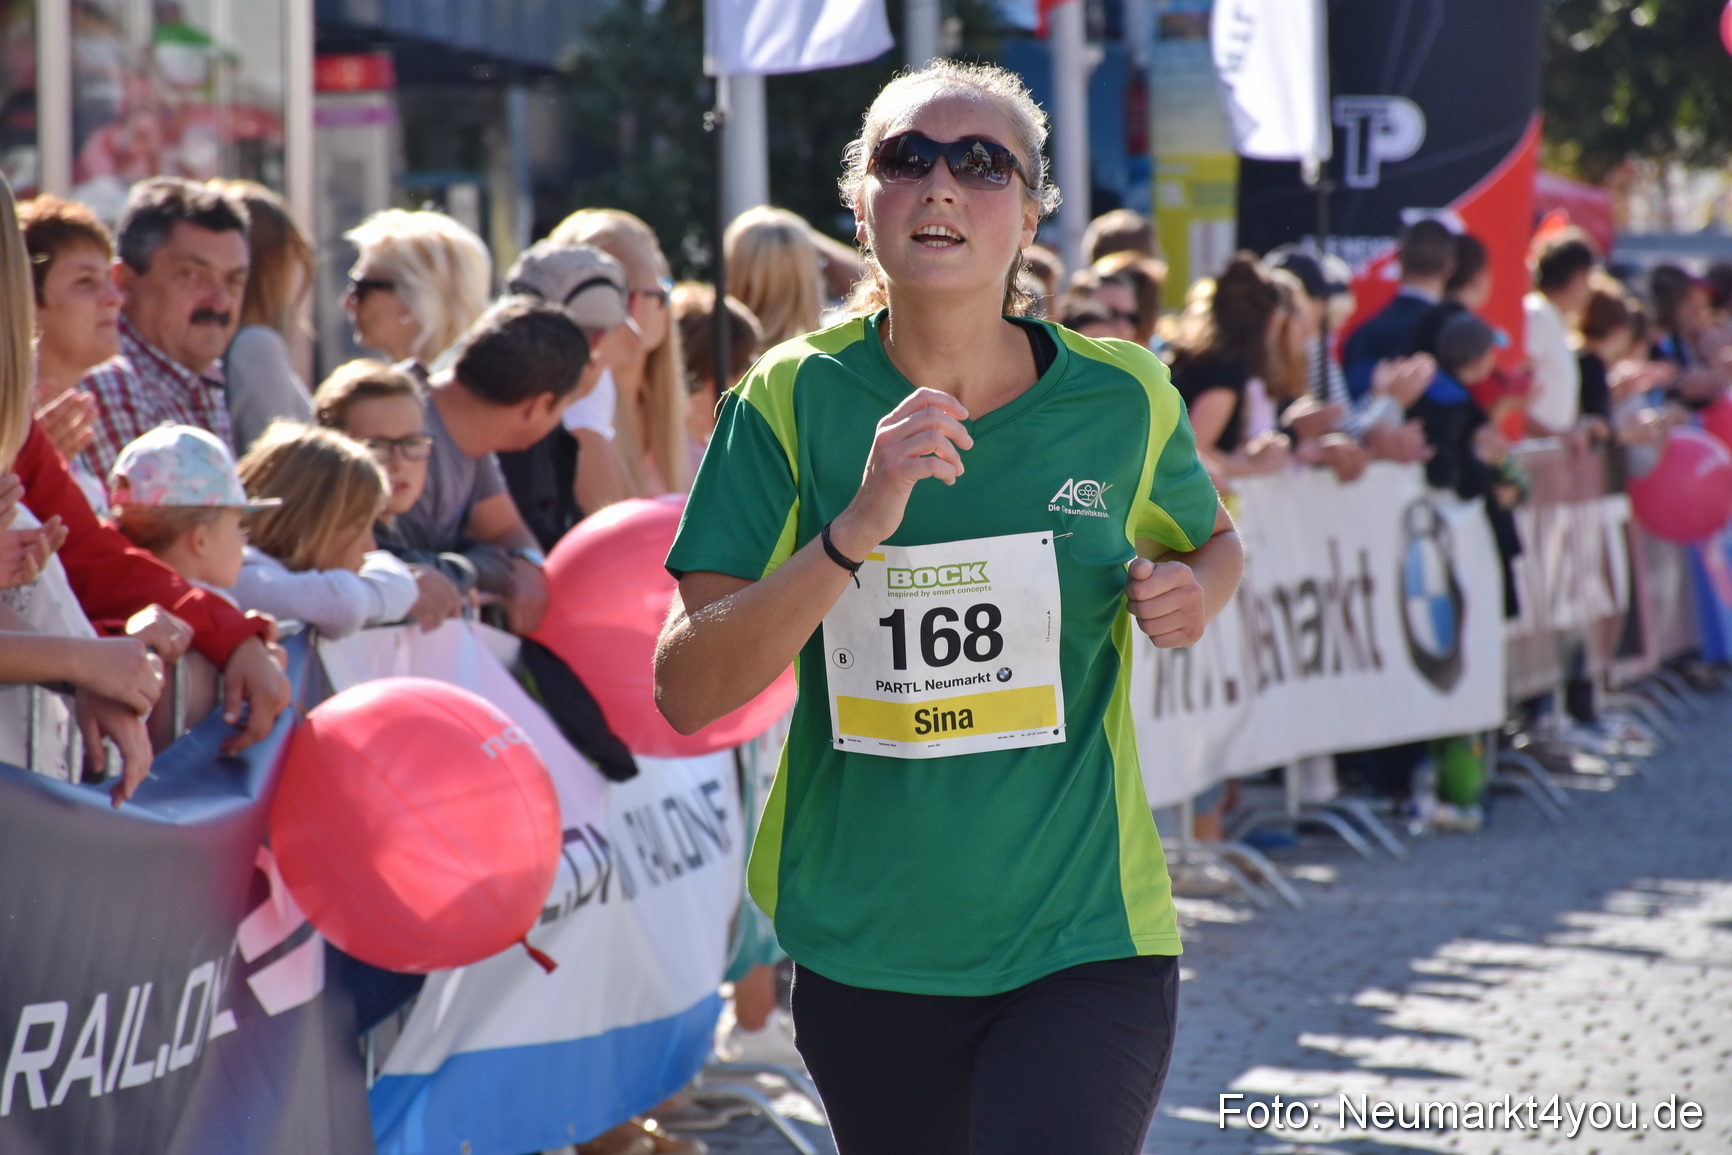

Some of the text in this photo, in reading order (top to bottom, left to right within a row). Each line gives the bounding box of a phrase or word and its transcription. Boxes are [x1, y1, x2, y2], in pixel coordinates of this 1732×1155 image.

[1048, 503, 1060, 511] Die
[1050, 478, 1114, 510] AOK
[887, 561, 990, 589] BOCK
[887, 585, 992, 598] inspired by smart concepts
[879, 603, 1004, 670] 168
[839, 653, 847, 664] B
[876, 672, 992, 693] PARTL Neumarkt
[914, 707, 974, 735] Sina
[0, 957, 238, 1117] RAIL.O
